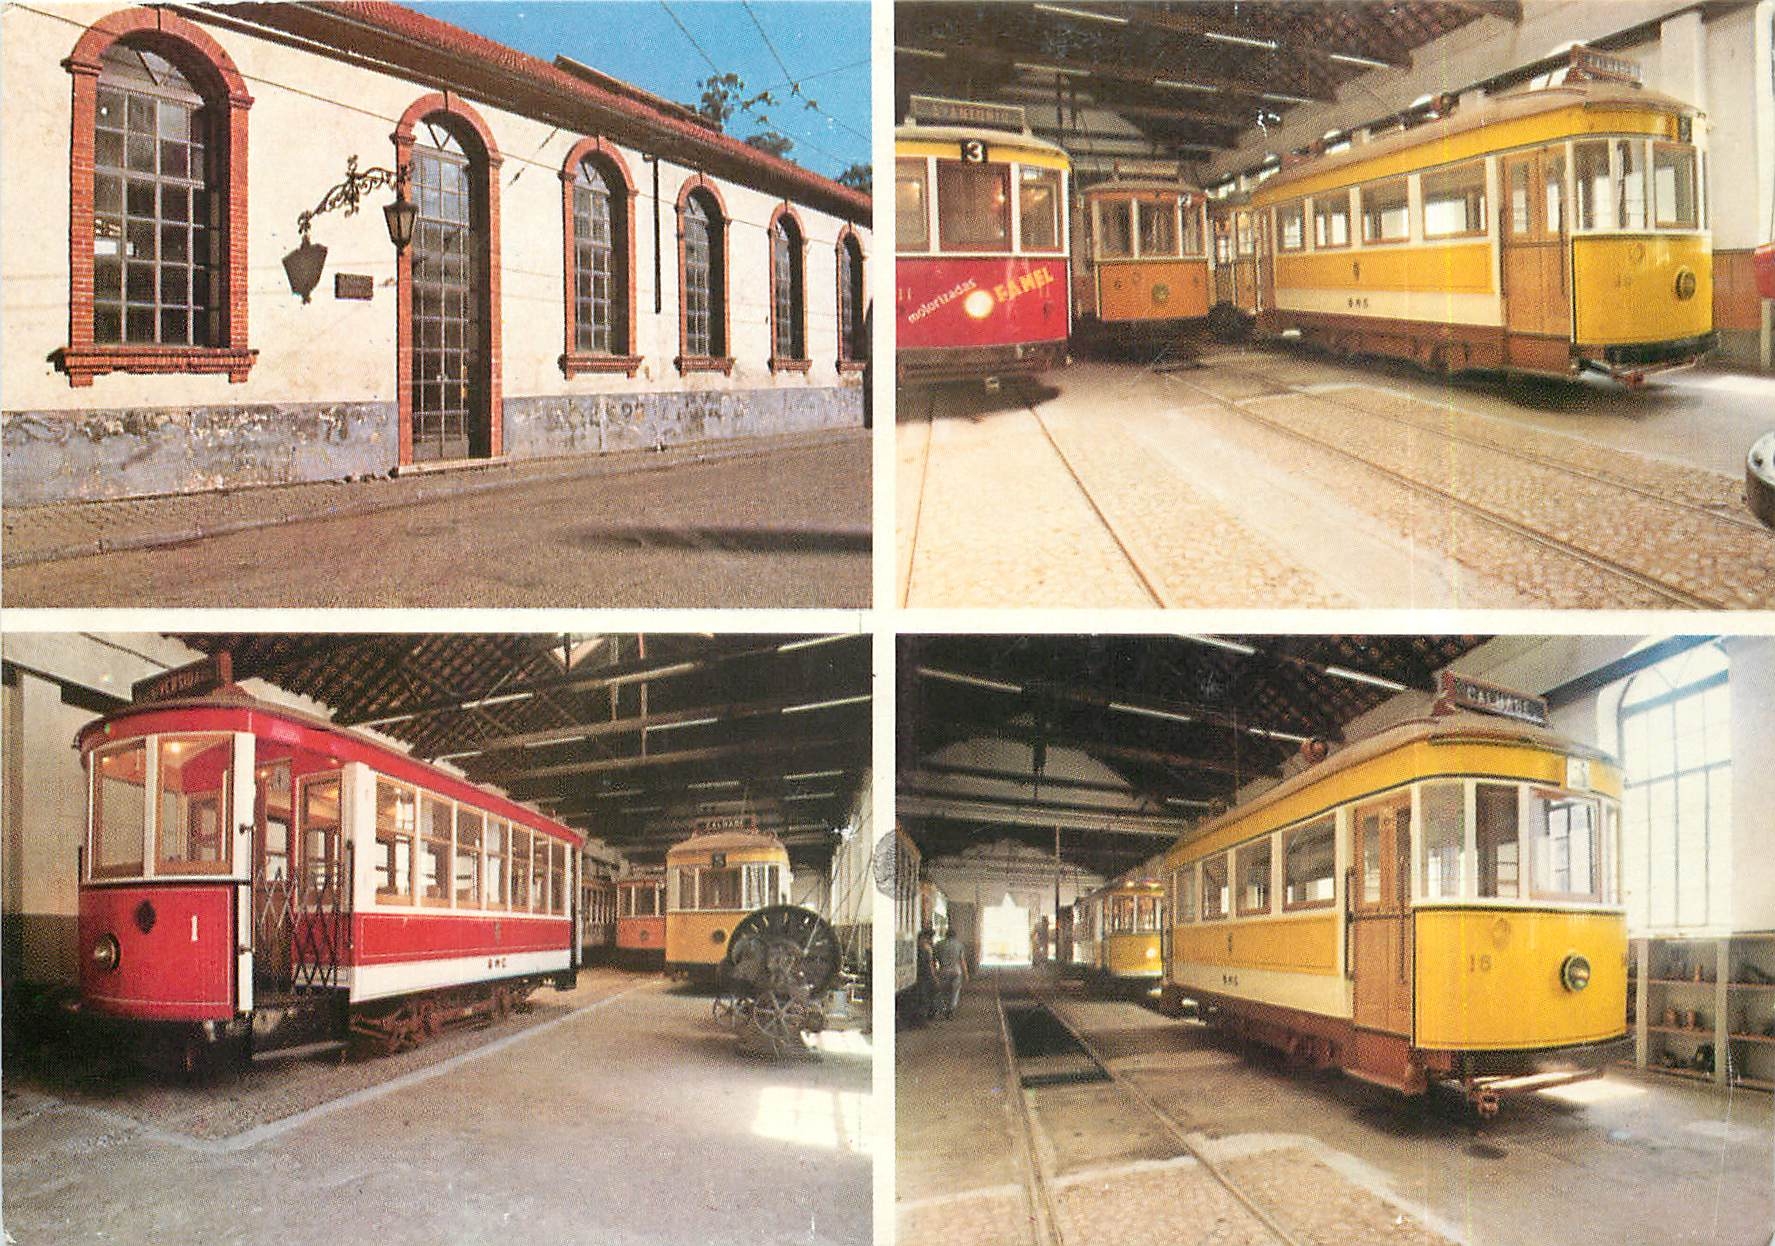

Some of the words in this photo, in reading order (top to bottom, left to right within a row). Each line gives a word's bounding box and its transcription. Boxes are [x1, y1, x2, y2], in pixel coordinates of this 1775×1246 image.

[967, 141, 983, 162] 3
[993, 266, 1054, 304] FAMEL
[190, 914, 199, 942] 1
